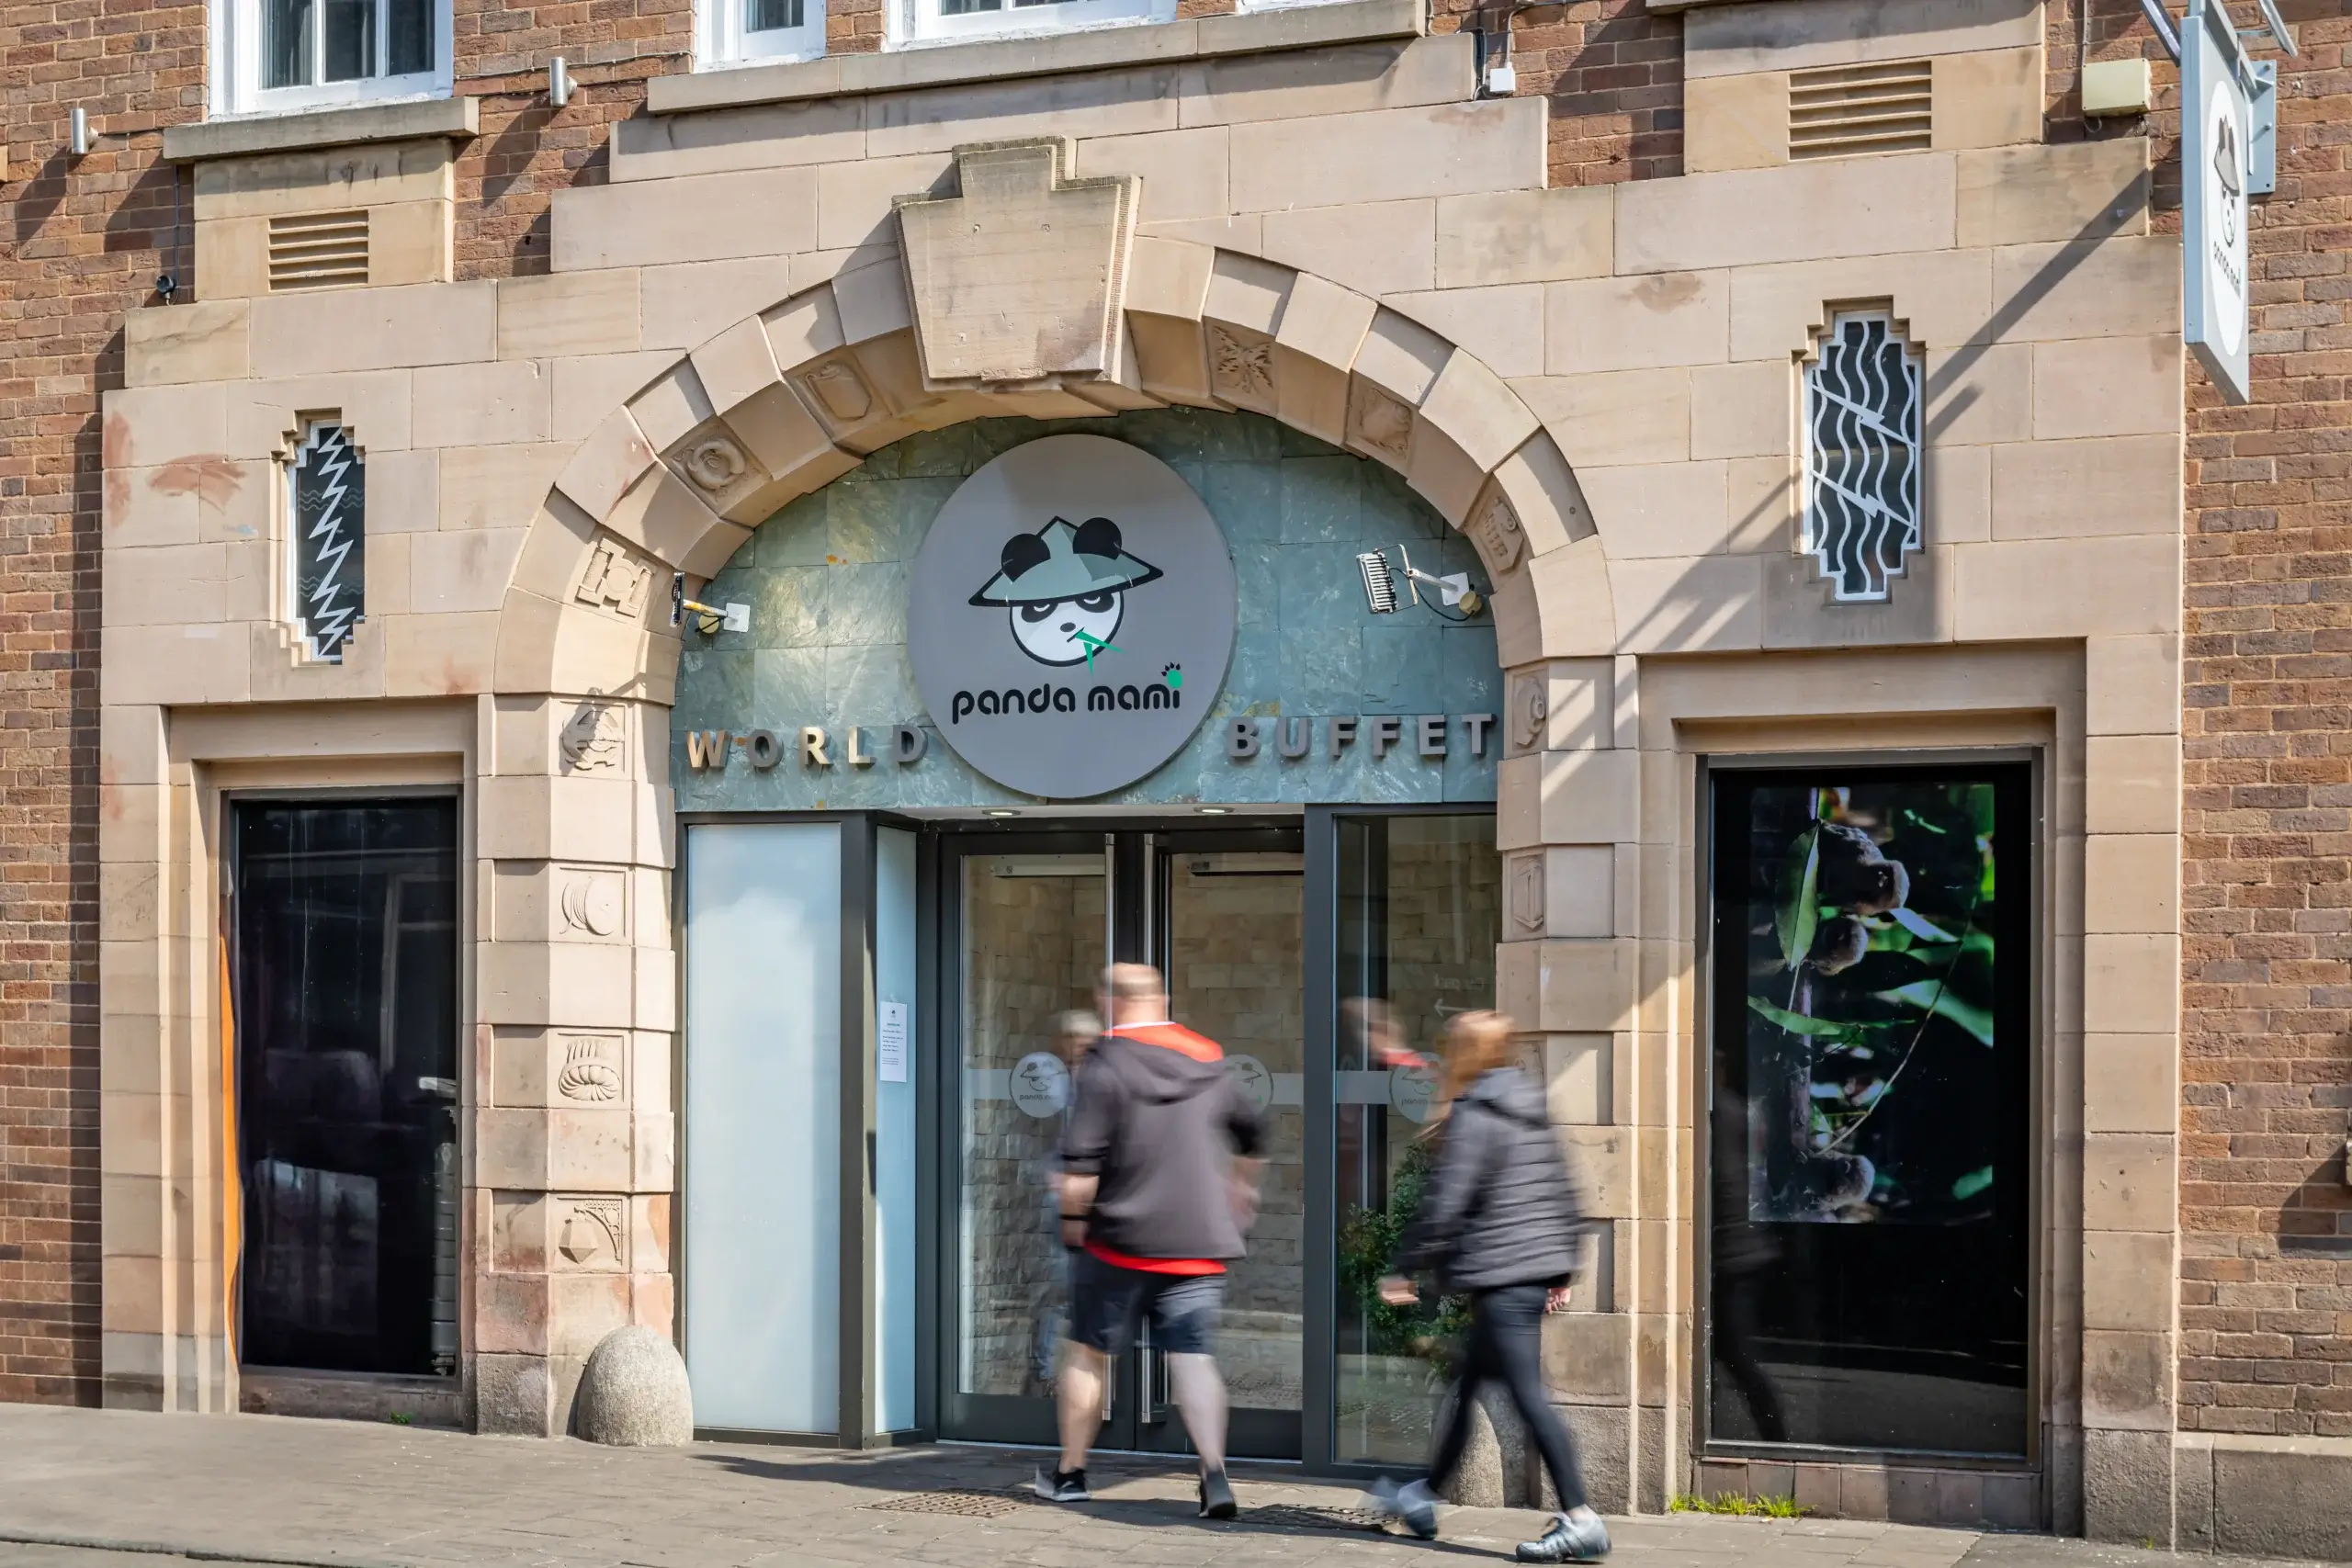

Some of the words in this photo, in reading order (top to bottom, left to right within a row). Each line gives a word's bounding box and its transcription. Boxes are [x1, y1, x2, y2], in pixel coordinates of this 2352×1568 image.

[952, 682, 1076, 725] panda
[1088, 671, 1182, 712] mami
[686, 724, 928, 770] WORLD
[1226, 712, 1496, 760] BUFFET
